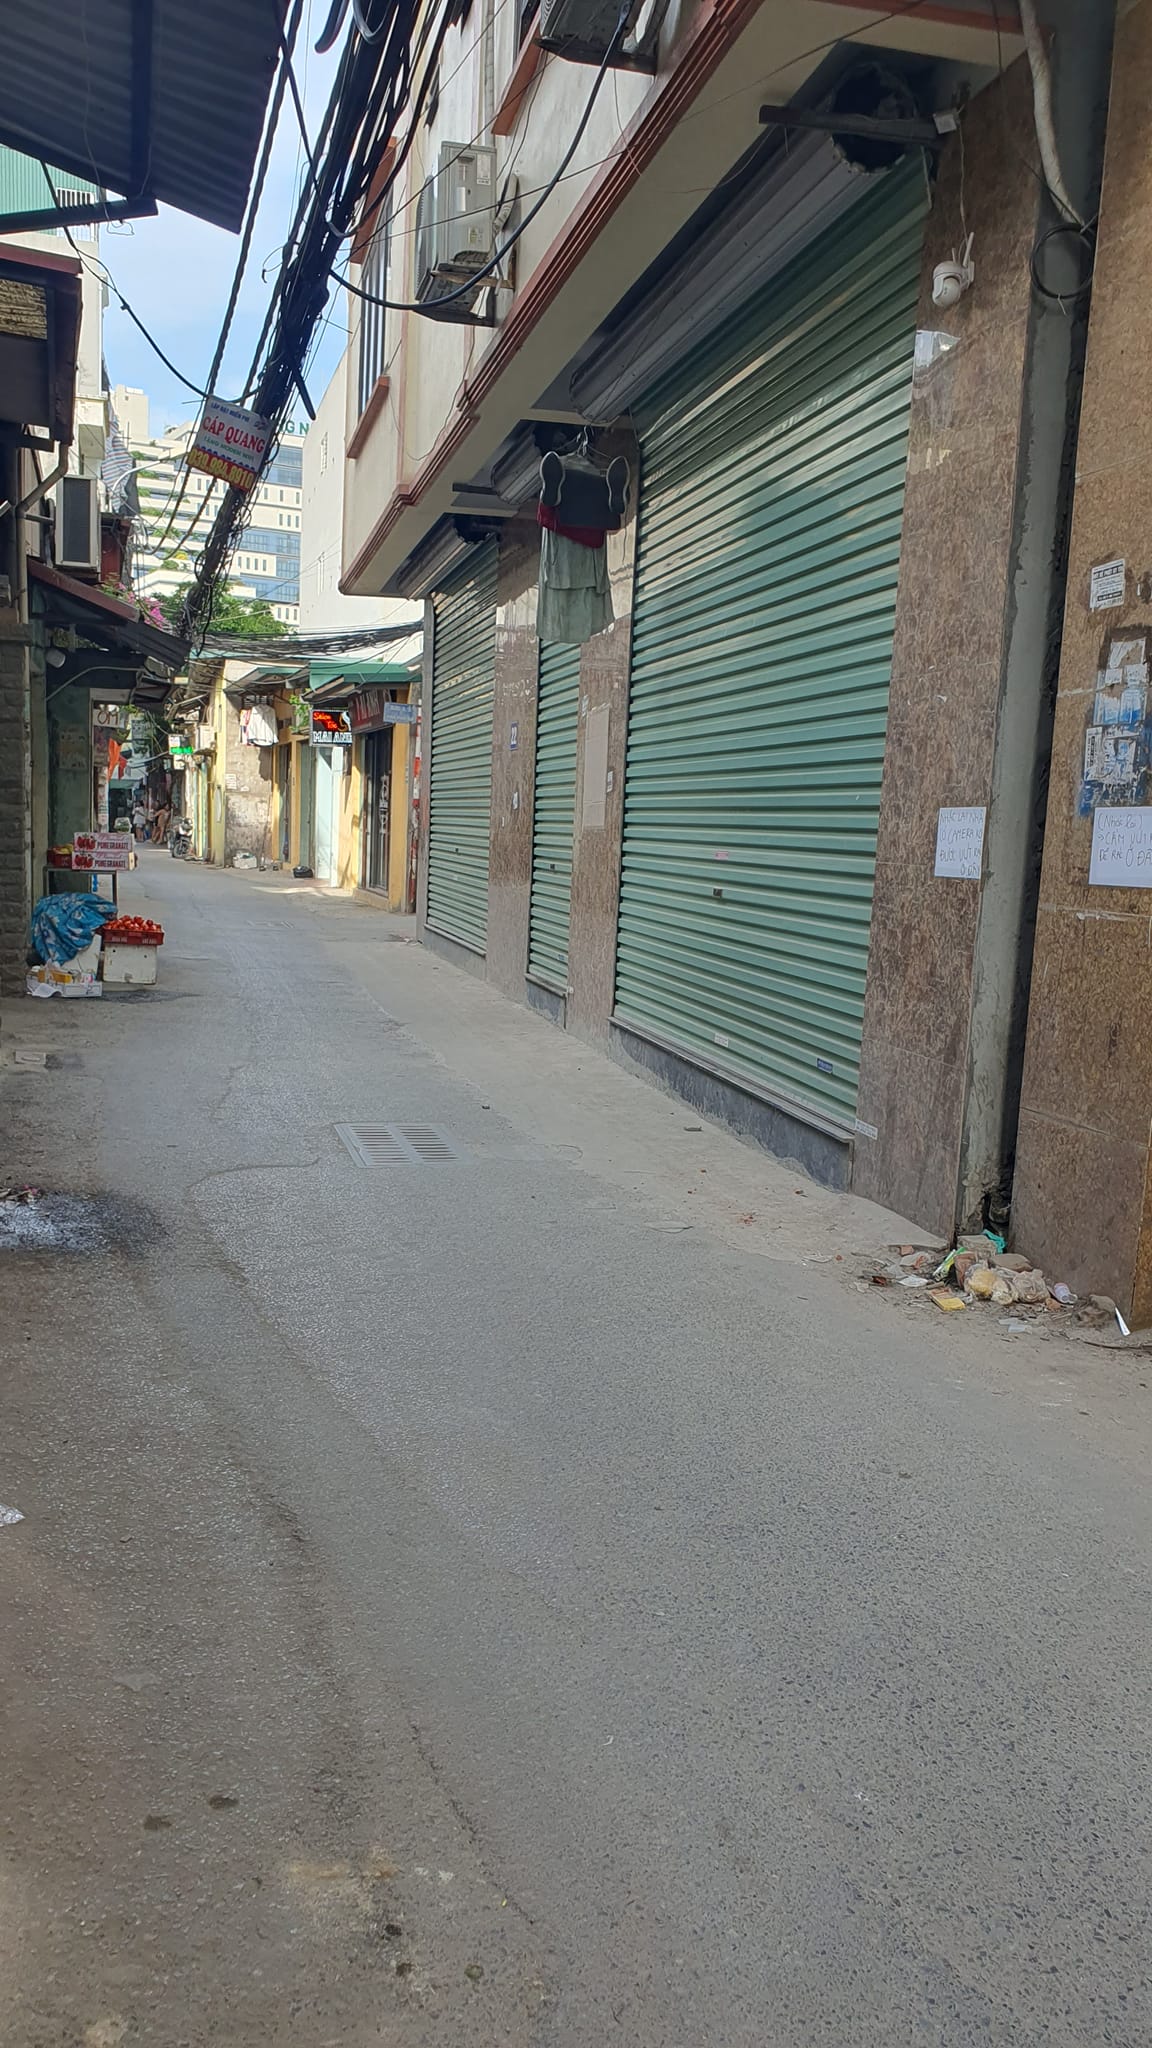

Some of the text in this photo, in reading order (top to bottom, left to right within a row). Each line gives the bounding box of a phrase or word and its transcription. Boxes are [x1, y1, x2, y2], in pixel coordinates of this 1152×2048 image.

[203, 416, 265, 453] CÁP QUANG
[97, 841, 128, 850] POMEGRANATE
[95, 860, 126, 868] POMEGRANATE
